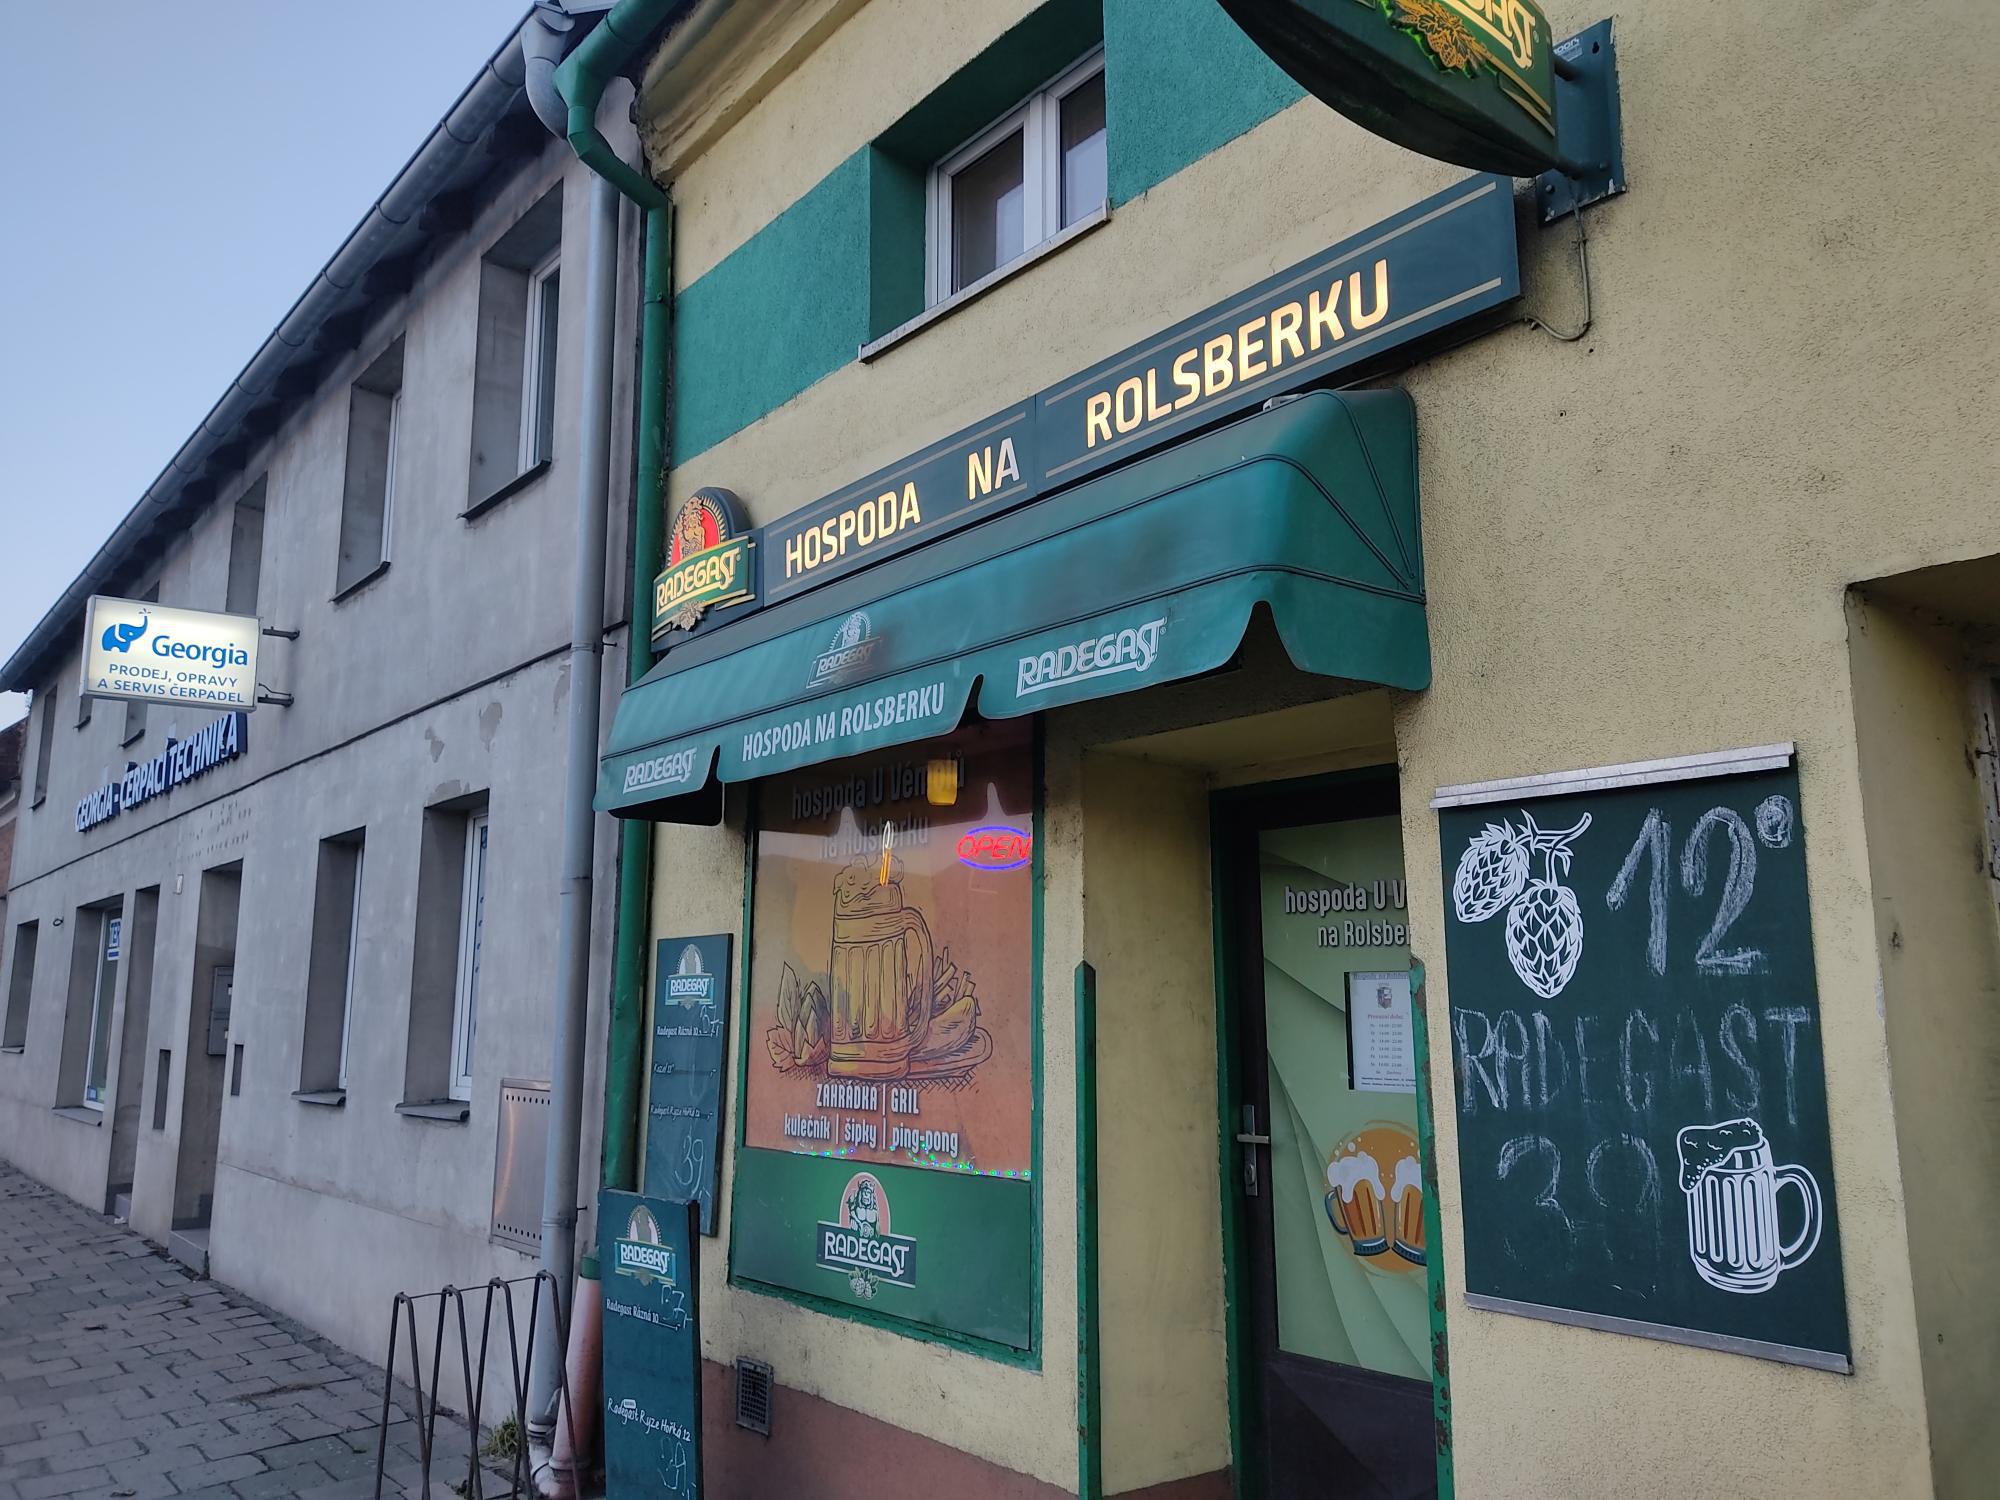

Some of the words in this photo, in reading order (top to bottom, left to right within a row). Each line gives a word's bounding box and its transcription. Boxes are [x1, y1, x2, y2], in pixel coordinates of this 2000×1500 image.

[784, 481, 921, 579] HOSPODA
[967, 437, 1021, 500] NA
[1086, 258, 1389, 449] ROLSBERKU
[656, 547, 741, 618] RADEGAST
[152, 635, 248, 669] Georgia
[1015, 617, 1166, 699] RADEGAST
[97, 678, 108, 689] A
[114, 680, 165, 695] SERVIS
[169, 683, 245, 703] ČERPADEL
[109, 663, 172, 682] PRODEJ,
[176, 672, 238, 688] OPRAVY
[742, 722, 812, 763] HOSPODA
[815, 713, 836, 741] NA
[840, 682, 945, 738] ROLSBERKU
[75, 782, 113, 833] GEORGIA
[168, 712, 237, 789] TECHNIKA
[623, 747, 698, 794] RADEGAST
[792, 768, 866, 821] hospoda
[957, 835, 1032, 860] OPEN
[1285, 881, 1367, 917] hospoda
[1373, 879, 1386, 910] U
[1318, 926, 1339, 947] na
[670, 978, 710, 997] RADEGAST
[1454, 1002, 1811, 1125] RADEGAST
[816, 1081, 878, 1112] ZAHRÁDKA
[891, 1088, 919, 1114] GRIL
[784, 1112, 831, 1140] kulečník
[844, 1117, 877, 1148] šipky
[892, 1122, 959, 1158] ping-pong
[621, 1243, 670, 1275] RADEGAST
[824, 1231, 910, 1278] RADEGAST
[606, 1298, 633, 1316] Radegast
